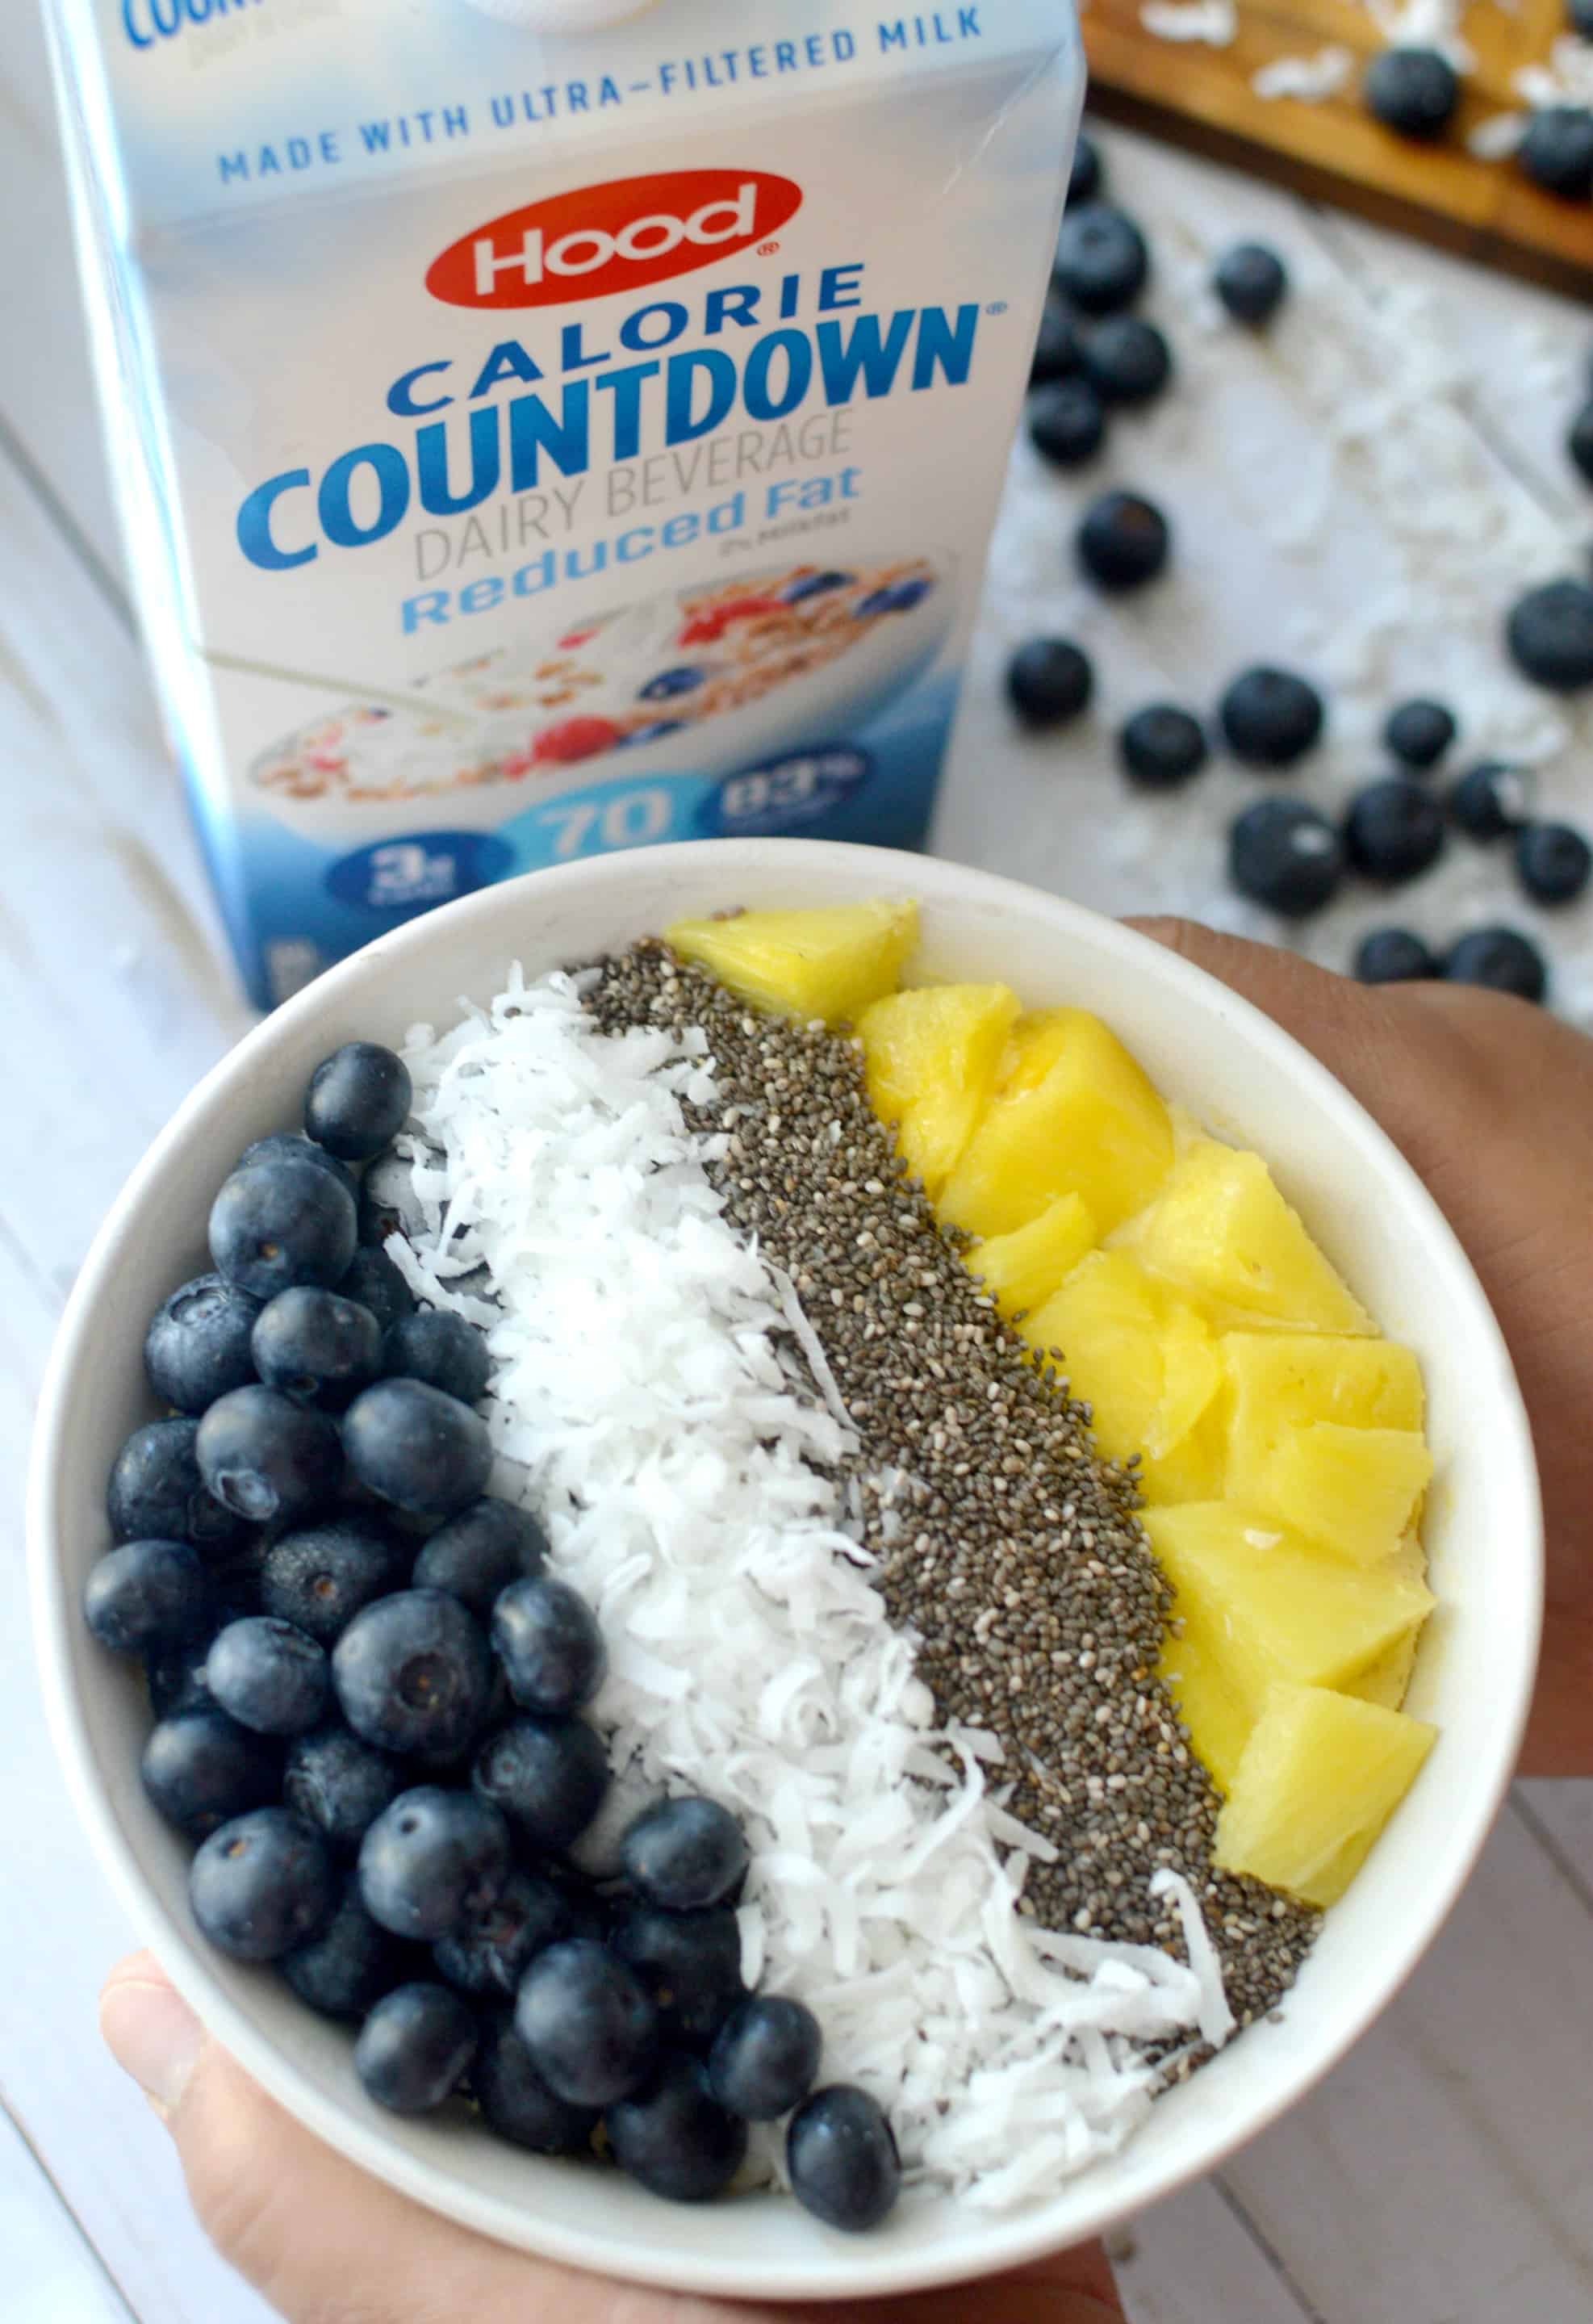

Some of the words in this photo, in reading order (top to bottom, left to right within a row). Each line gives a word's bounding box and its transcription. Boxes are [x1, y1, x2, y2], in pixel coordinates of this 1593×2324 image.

[218, 130, 342, 185] MADE
[359, 105, 470, 155] WITH
[878, 6, 982, 55] MILK
[473, 182, 758, 295] Hood
[386, 262, 865, 417] CALORIE
[235, 303, 980, 572] COUNTDOWN
[413, 478, 585, 583] DAIRY
[606, 408, 855, 518] BEVERAGE
[400, 490, 746, 636] Reduced
[765, 466, 863, 519] Fat
[535, 788, 675, 859] 70
